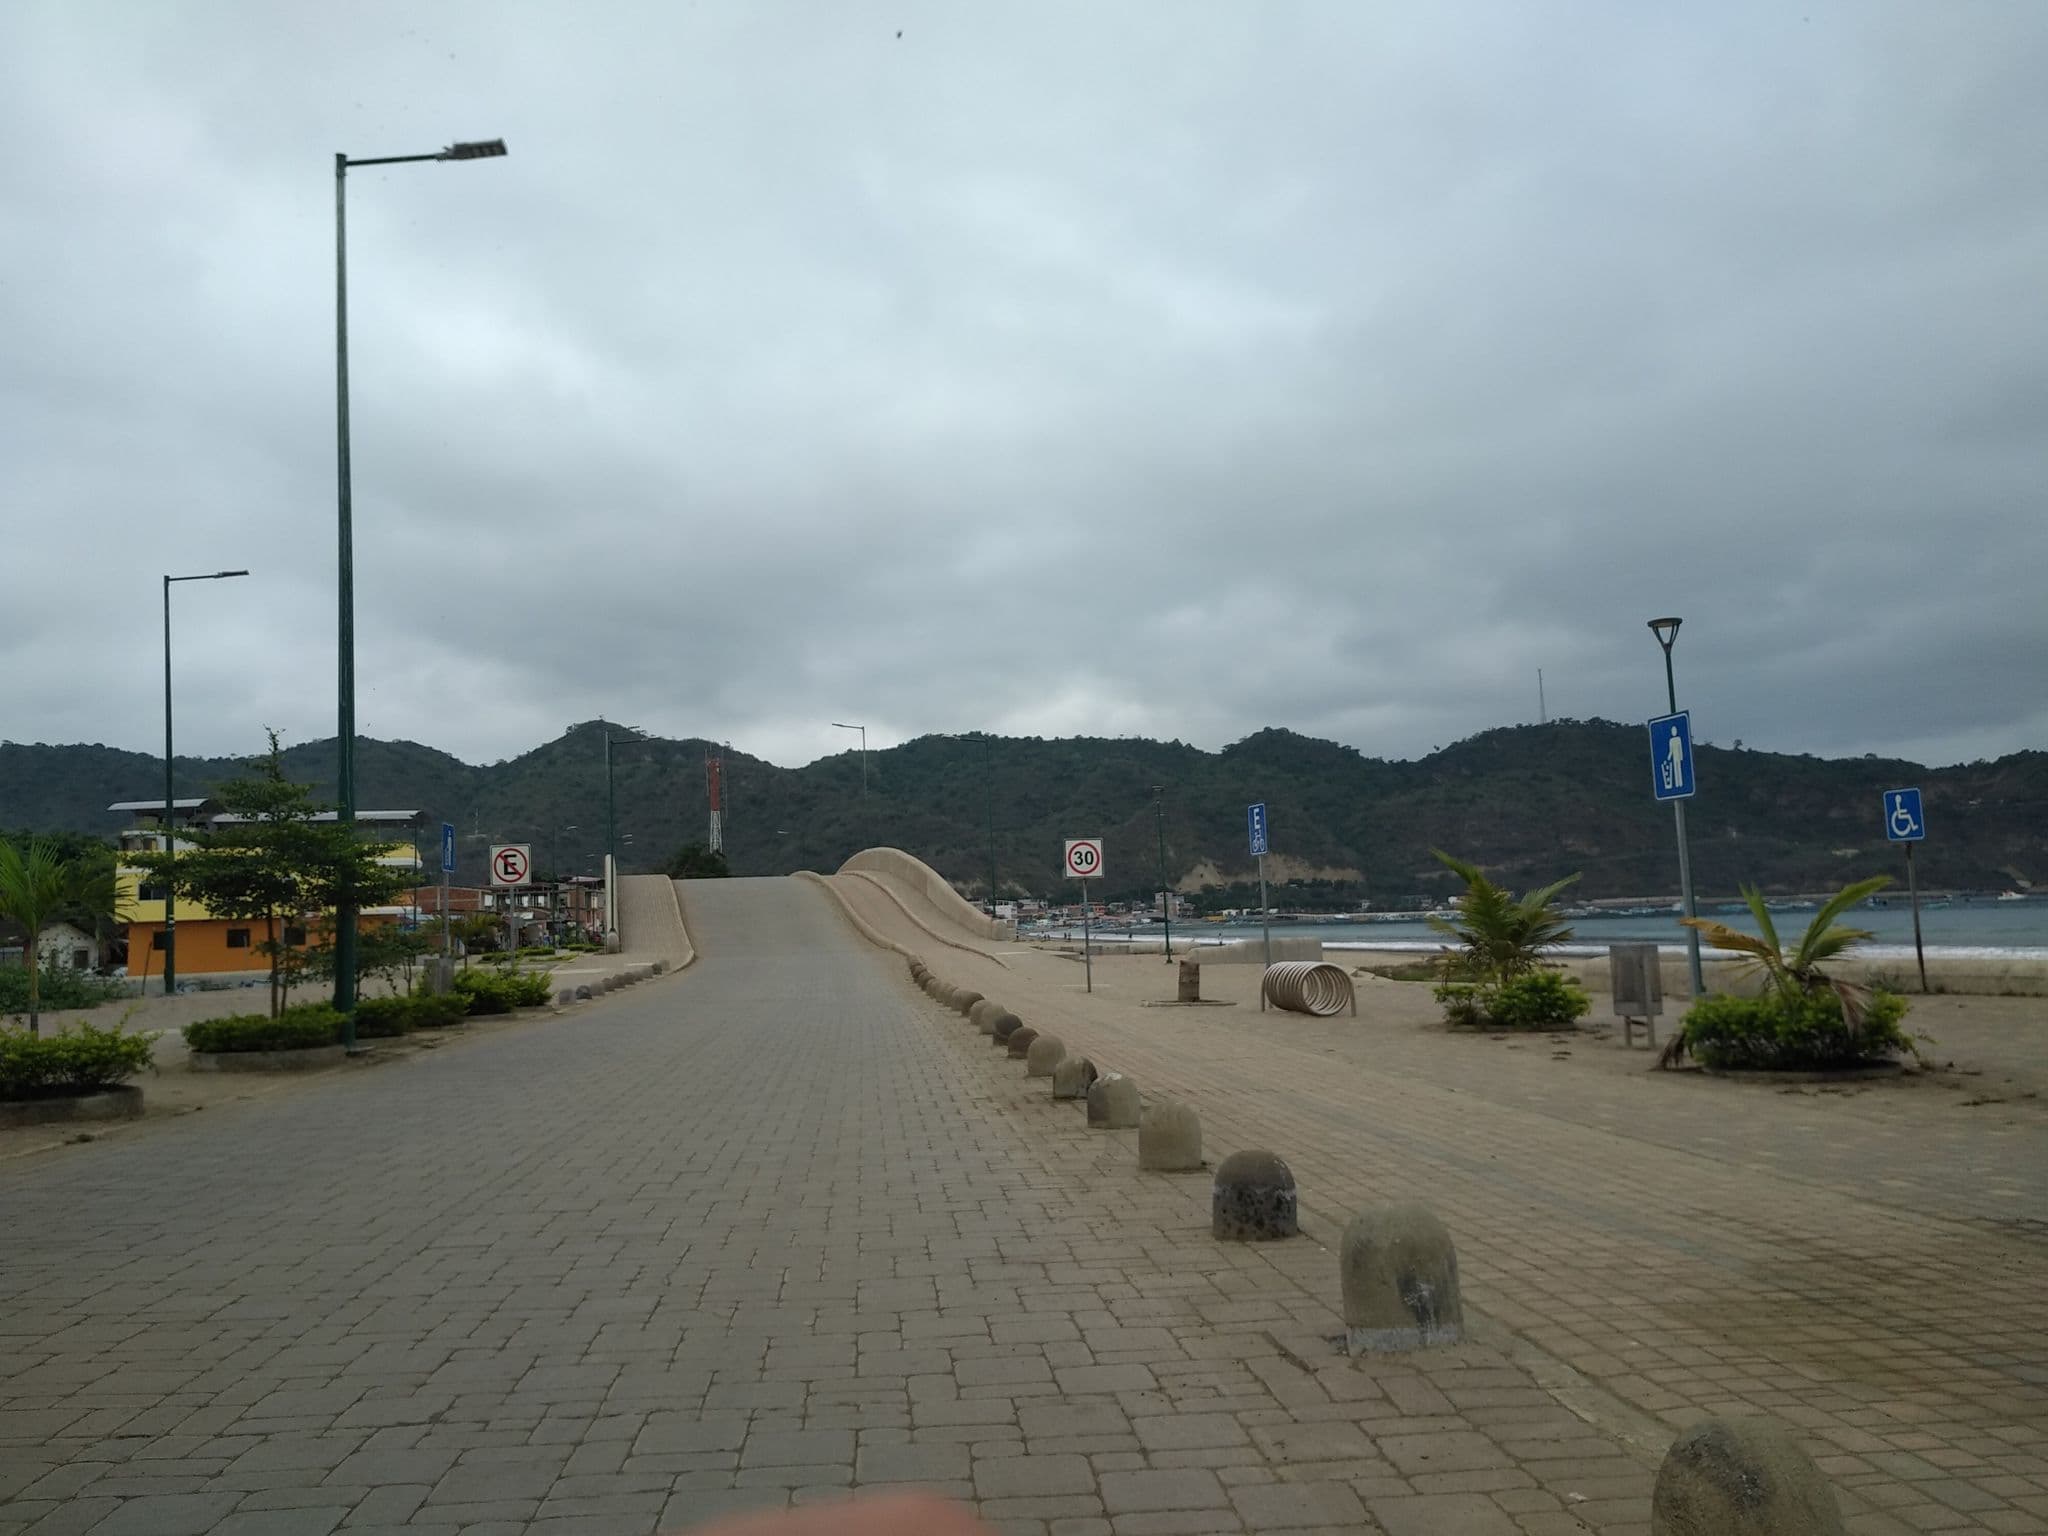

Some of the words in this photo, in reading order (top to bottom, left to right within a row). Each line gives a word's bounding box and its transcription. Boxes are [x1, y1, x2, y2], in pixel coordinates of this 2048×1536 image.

[1253, 807, 1261, 830] E
[503, 854, 518, 875] E
[1074, 850, 1094, 866] 30
